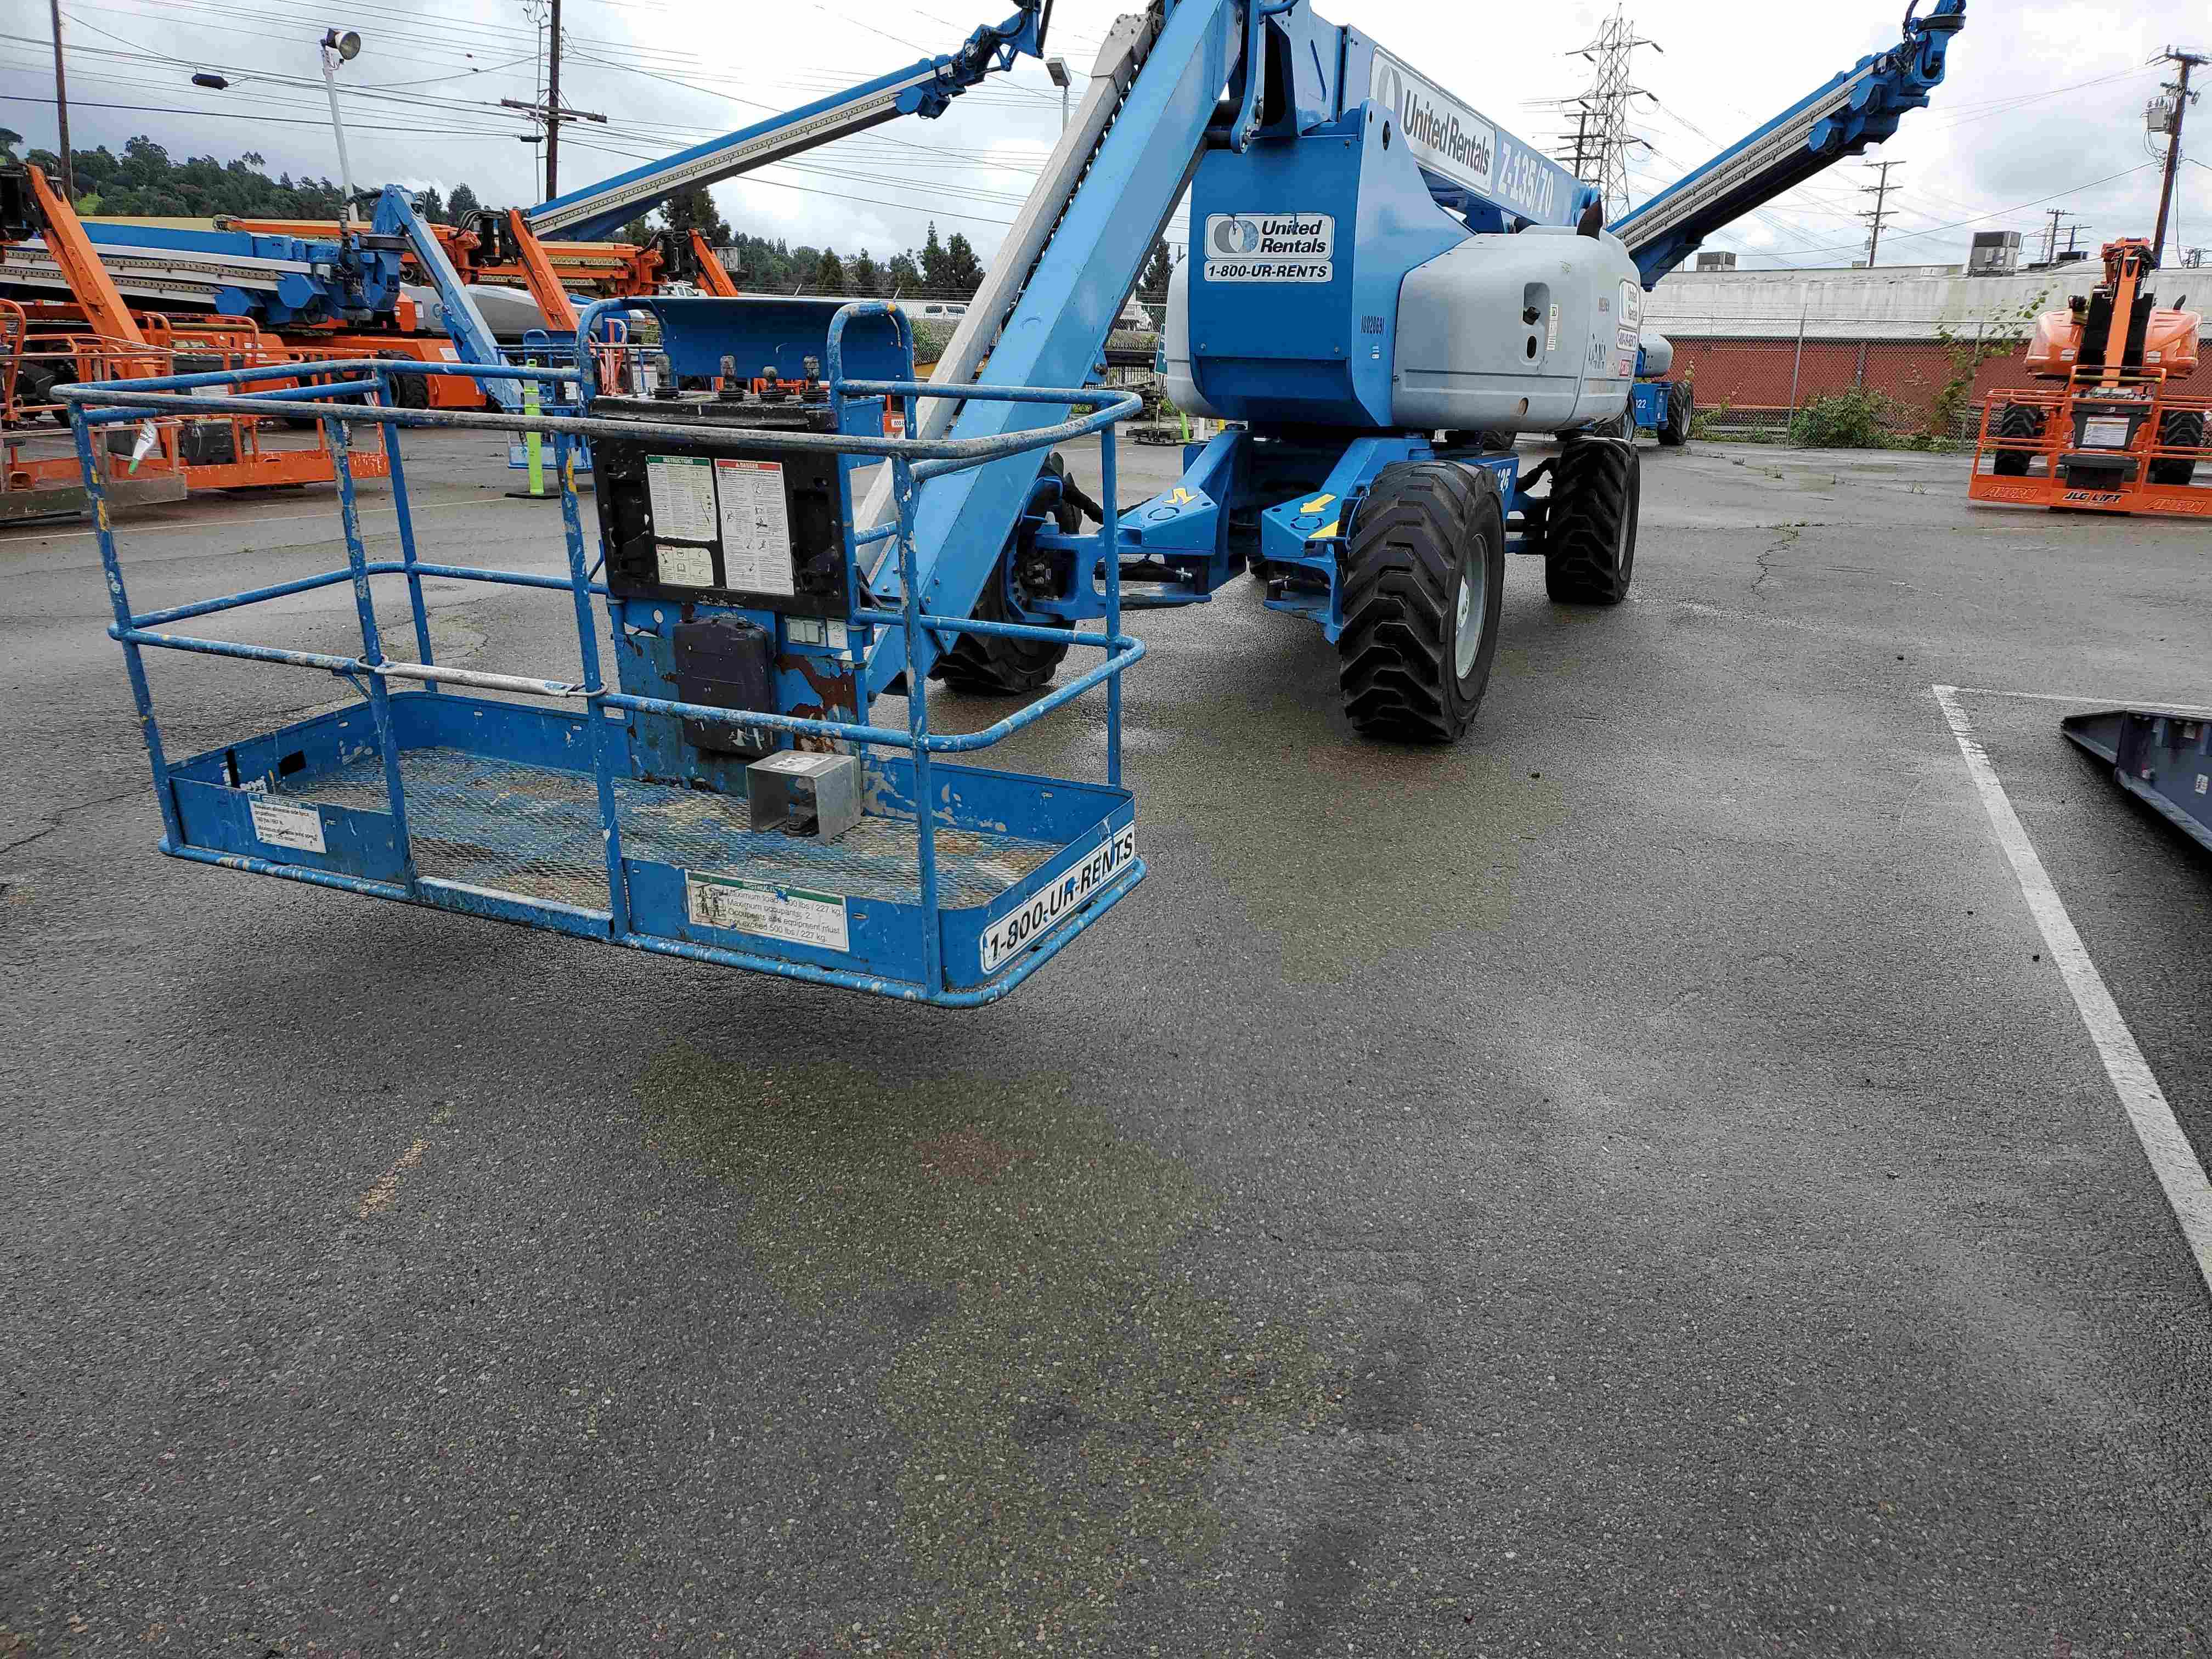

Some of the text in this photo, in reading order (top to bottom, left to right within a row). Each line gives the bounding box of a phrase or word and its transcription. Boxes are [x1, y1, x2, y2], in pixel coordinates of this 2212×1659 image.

[1403, 88, 1490, 176] United Rentals
[1497, 140, 1554, 219] Z-135/70
[1262, 220, 1323, 235] United
[1260, 238, 1327, 253] Rentals
[1209, 264, 1328, 278] 1-800-UR-RENTS
[816, 904, 830, 913] 227
[769, 924, 783, 933] 500
[800, 931, 814, 940] 227
